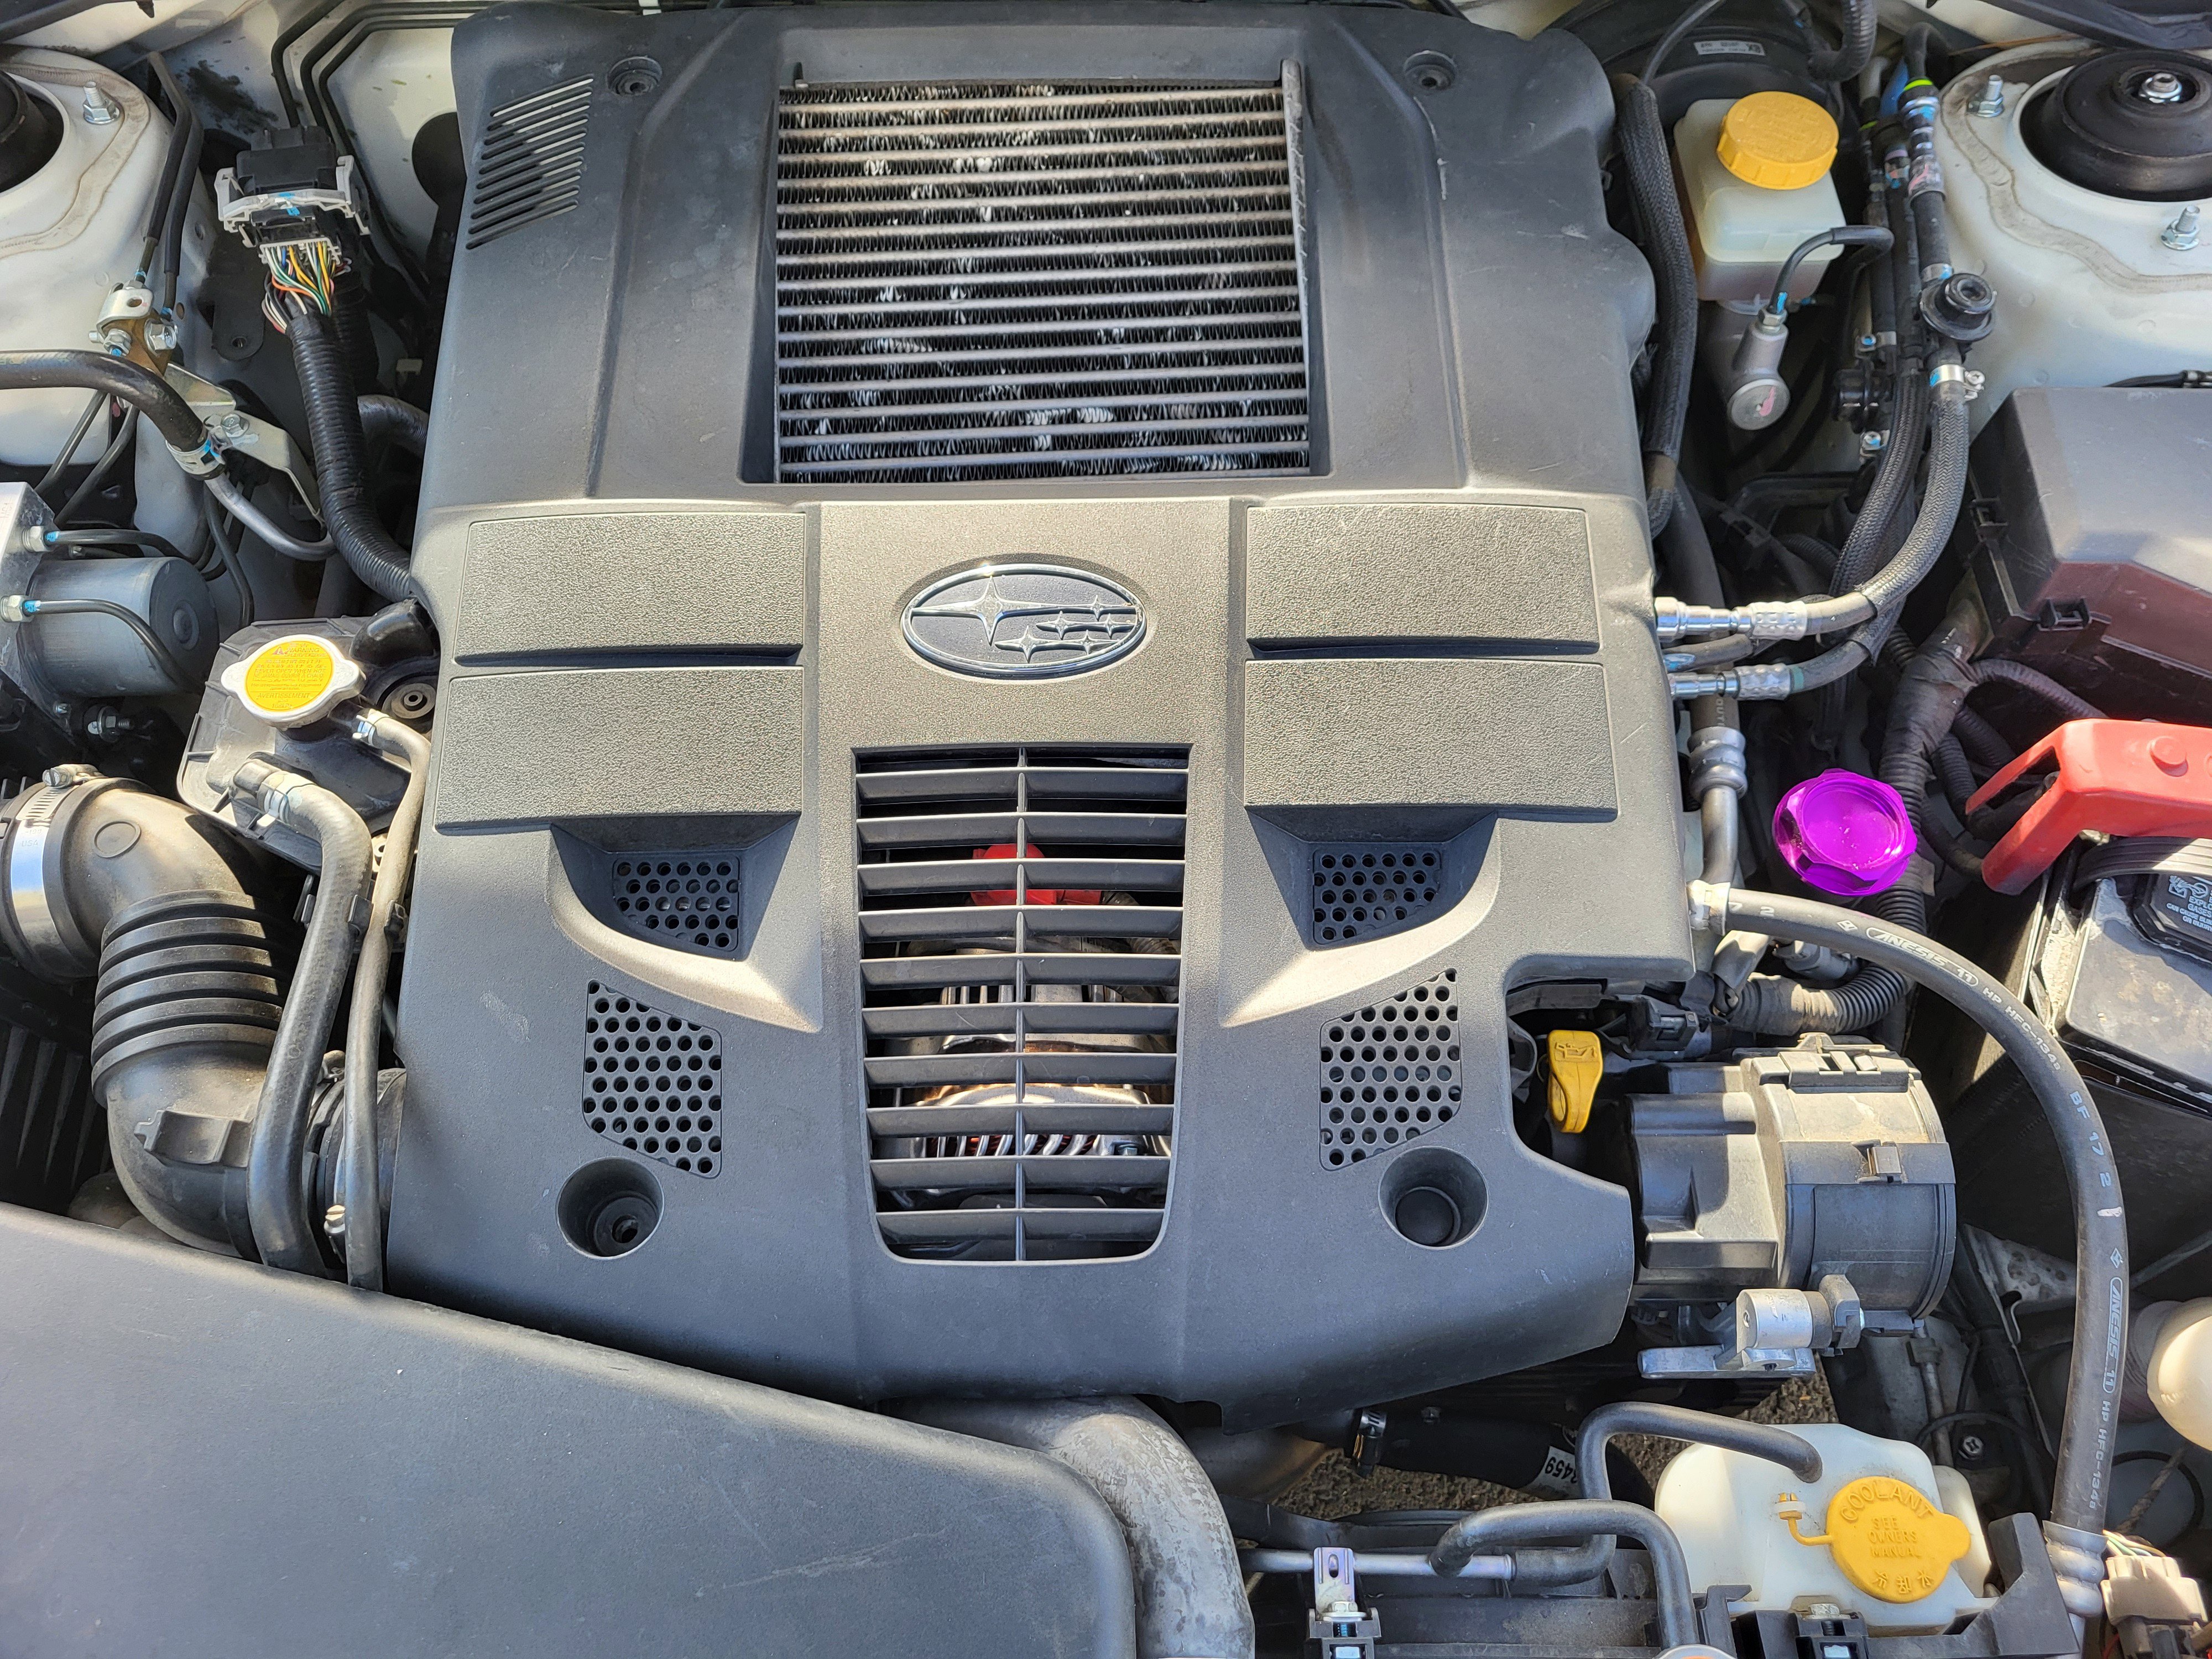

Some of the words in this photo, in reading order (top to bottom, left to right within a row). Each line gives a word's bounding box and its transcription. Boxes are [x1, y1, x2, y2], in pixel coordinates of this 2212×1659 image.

[1760, 906, 1774, 916] 2
[2187, 903, 2212, 919] GASES
[1874, 932, 1949, 967] ANESIS
[1957, 968, 1973, 983] 11
[1982, 987, 2002, 1004] HP
[2005, 1005, 2061, 1071] HFC-134a
[2070, 1091, 2090, 1119] BF
[2089, 1131, 2104, 1156] 17
[2099, 1172, 2111, 1187] 2
[2109, 1284, 2120, 1359] ANESIS
[2105, 1370, 2115, 1386] 11
[2102, 1400, 2111, 1422] HP
[2089, 1428, 2107, 1509] HFC-134a
[1840, 1480, 1933, 1521] COOLANT
[1872, 1516, 1898, 1530] SEE
[1868, 1531, 1917, 1544] OWNERS
[1870, 1547, 1921, 1558] MANUAL
